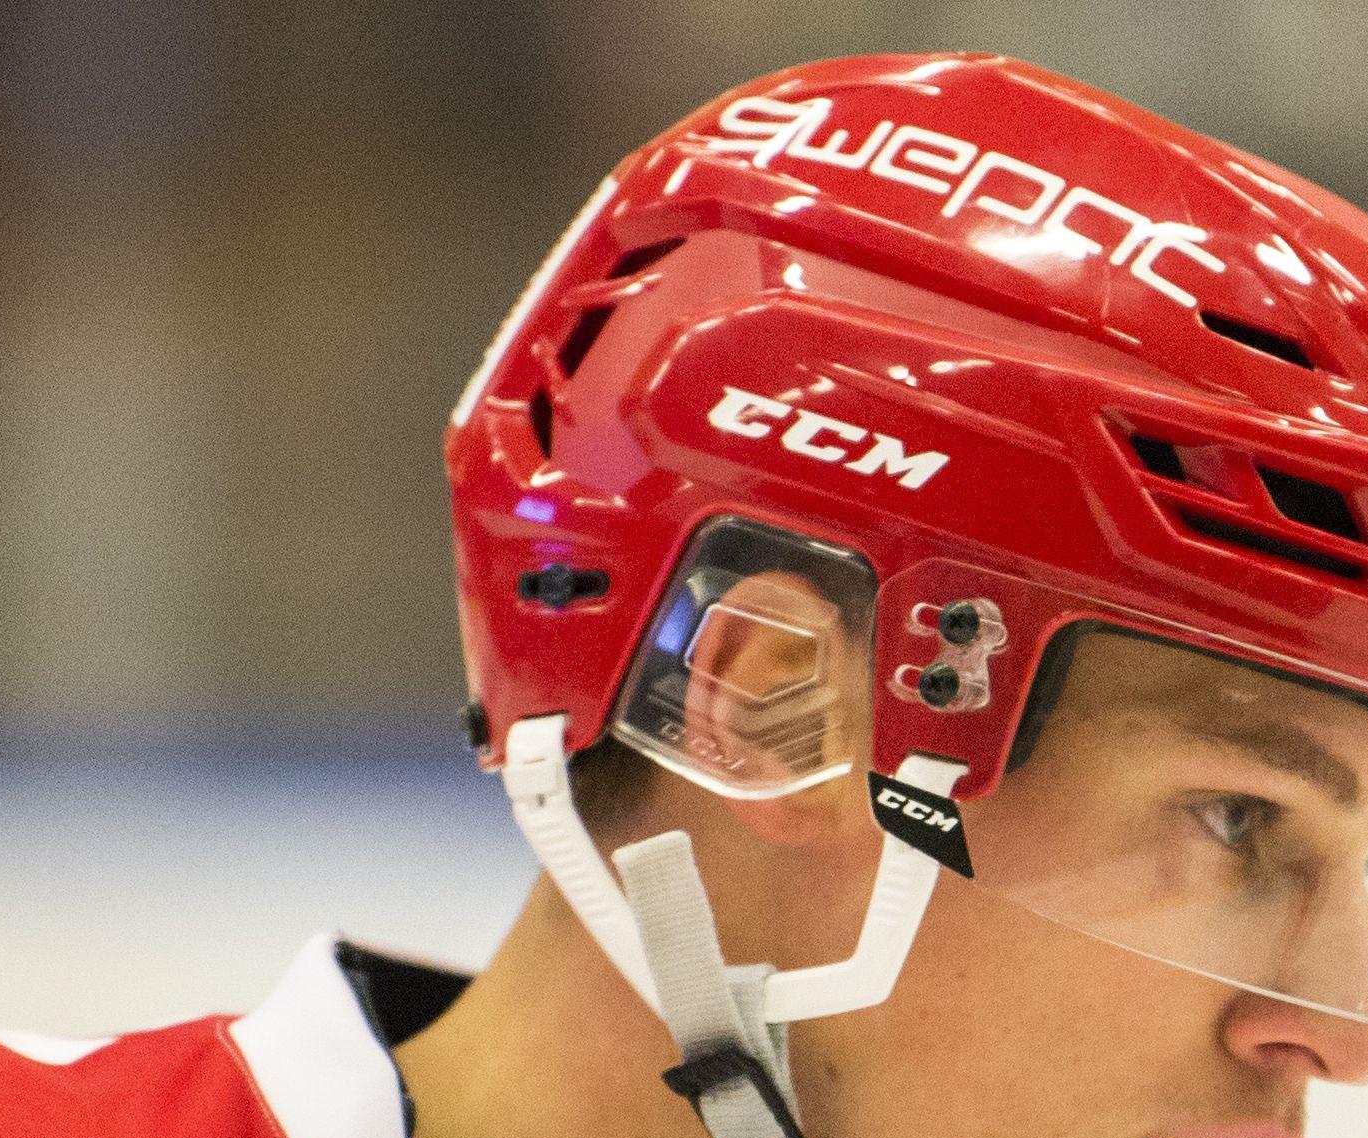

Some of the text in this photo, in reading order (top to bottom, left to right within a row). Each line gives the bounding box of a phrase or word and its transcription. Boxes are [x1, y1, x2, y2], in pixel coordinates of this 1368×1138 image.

[703, 97, 1228, 309] swepac
[707, 385, 949, 489] CCM
[877, 787, 959, 833] CCM
